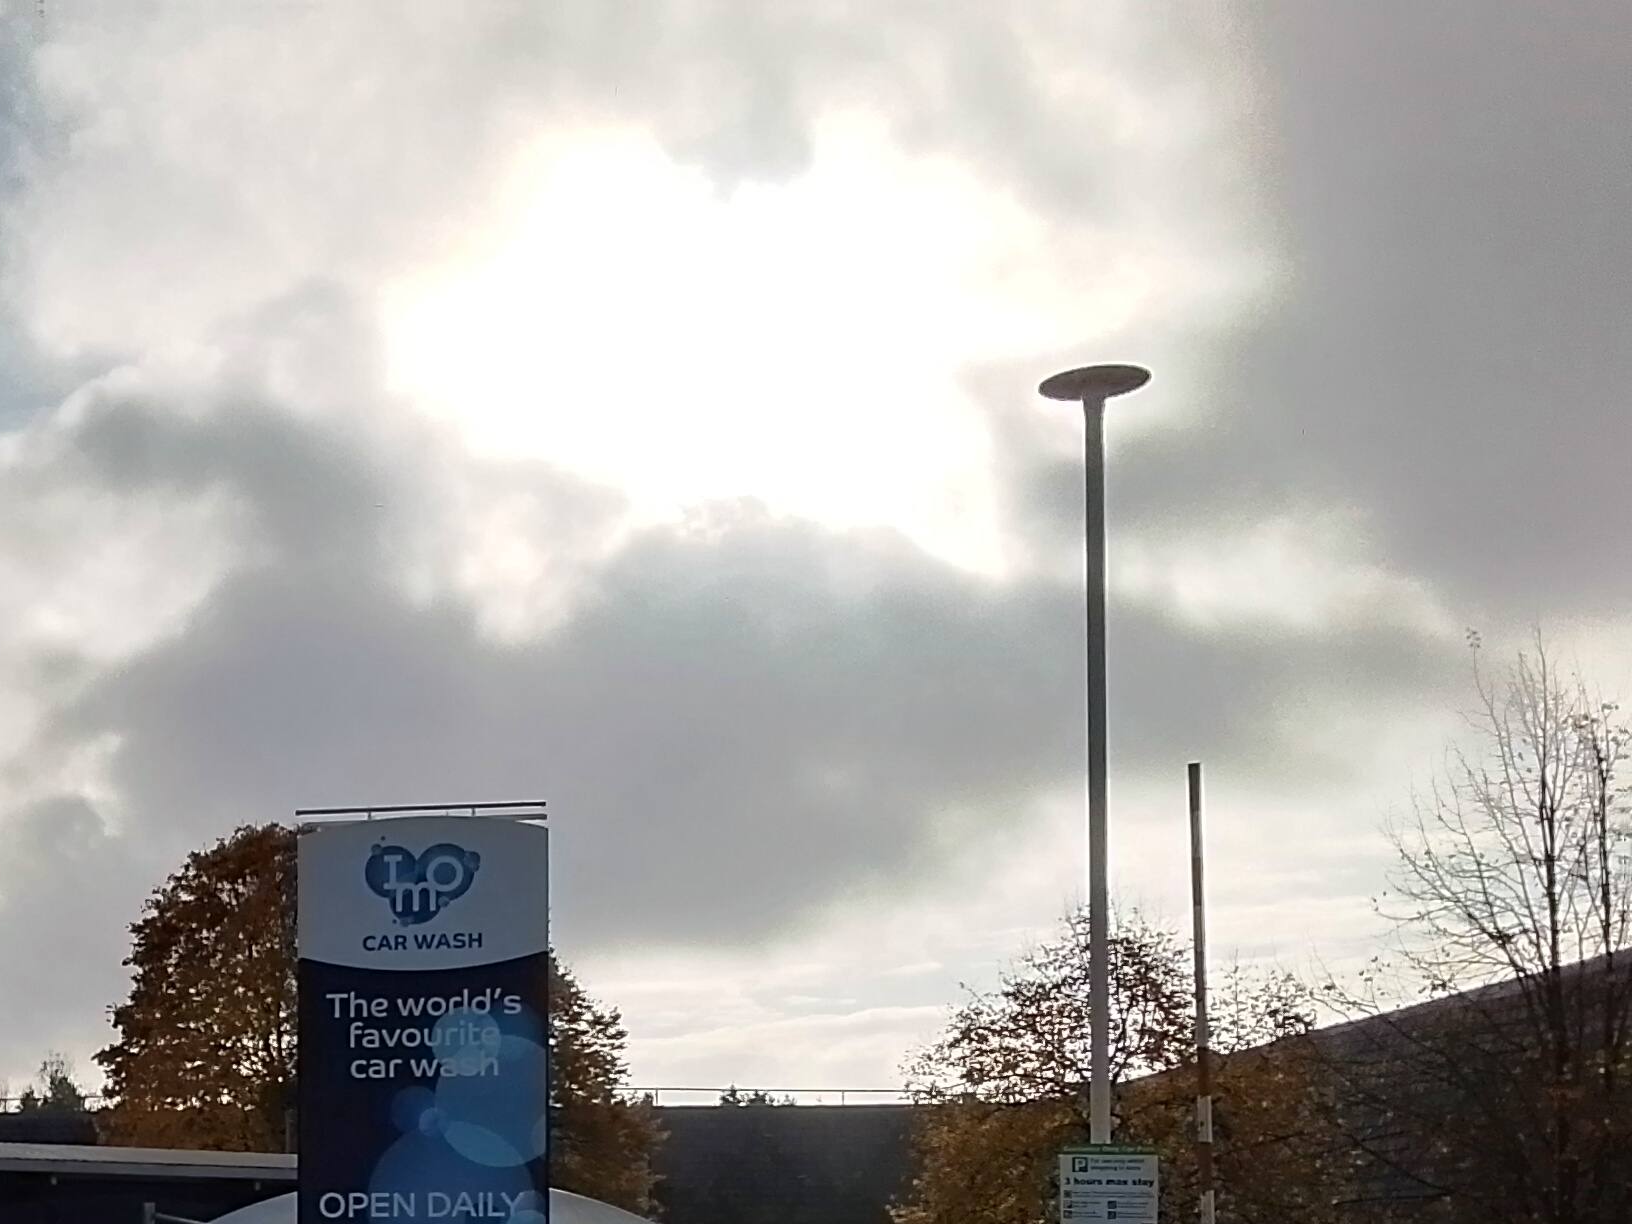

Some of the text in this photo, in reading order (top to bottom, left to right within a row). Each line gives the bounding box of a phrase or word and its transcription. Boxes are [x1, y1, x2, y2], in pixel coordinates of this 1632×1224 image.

[362, 932, 483, 951] CAR WASH
[326, 988, 522, 1018] The world's
[349, 1020, 501, 1048] favourite
[350, 1050, 499, 1078] car wash
[1074, 1177, 1103, 1186] hours
[1105, 1178, 1128, 1186] max
[1131, 1177, 1155, 1188] stay
[319, 1191, 525, 1218] OPEN DAILY
